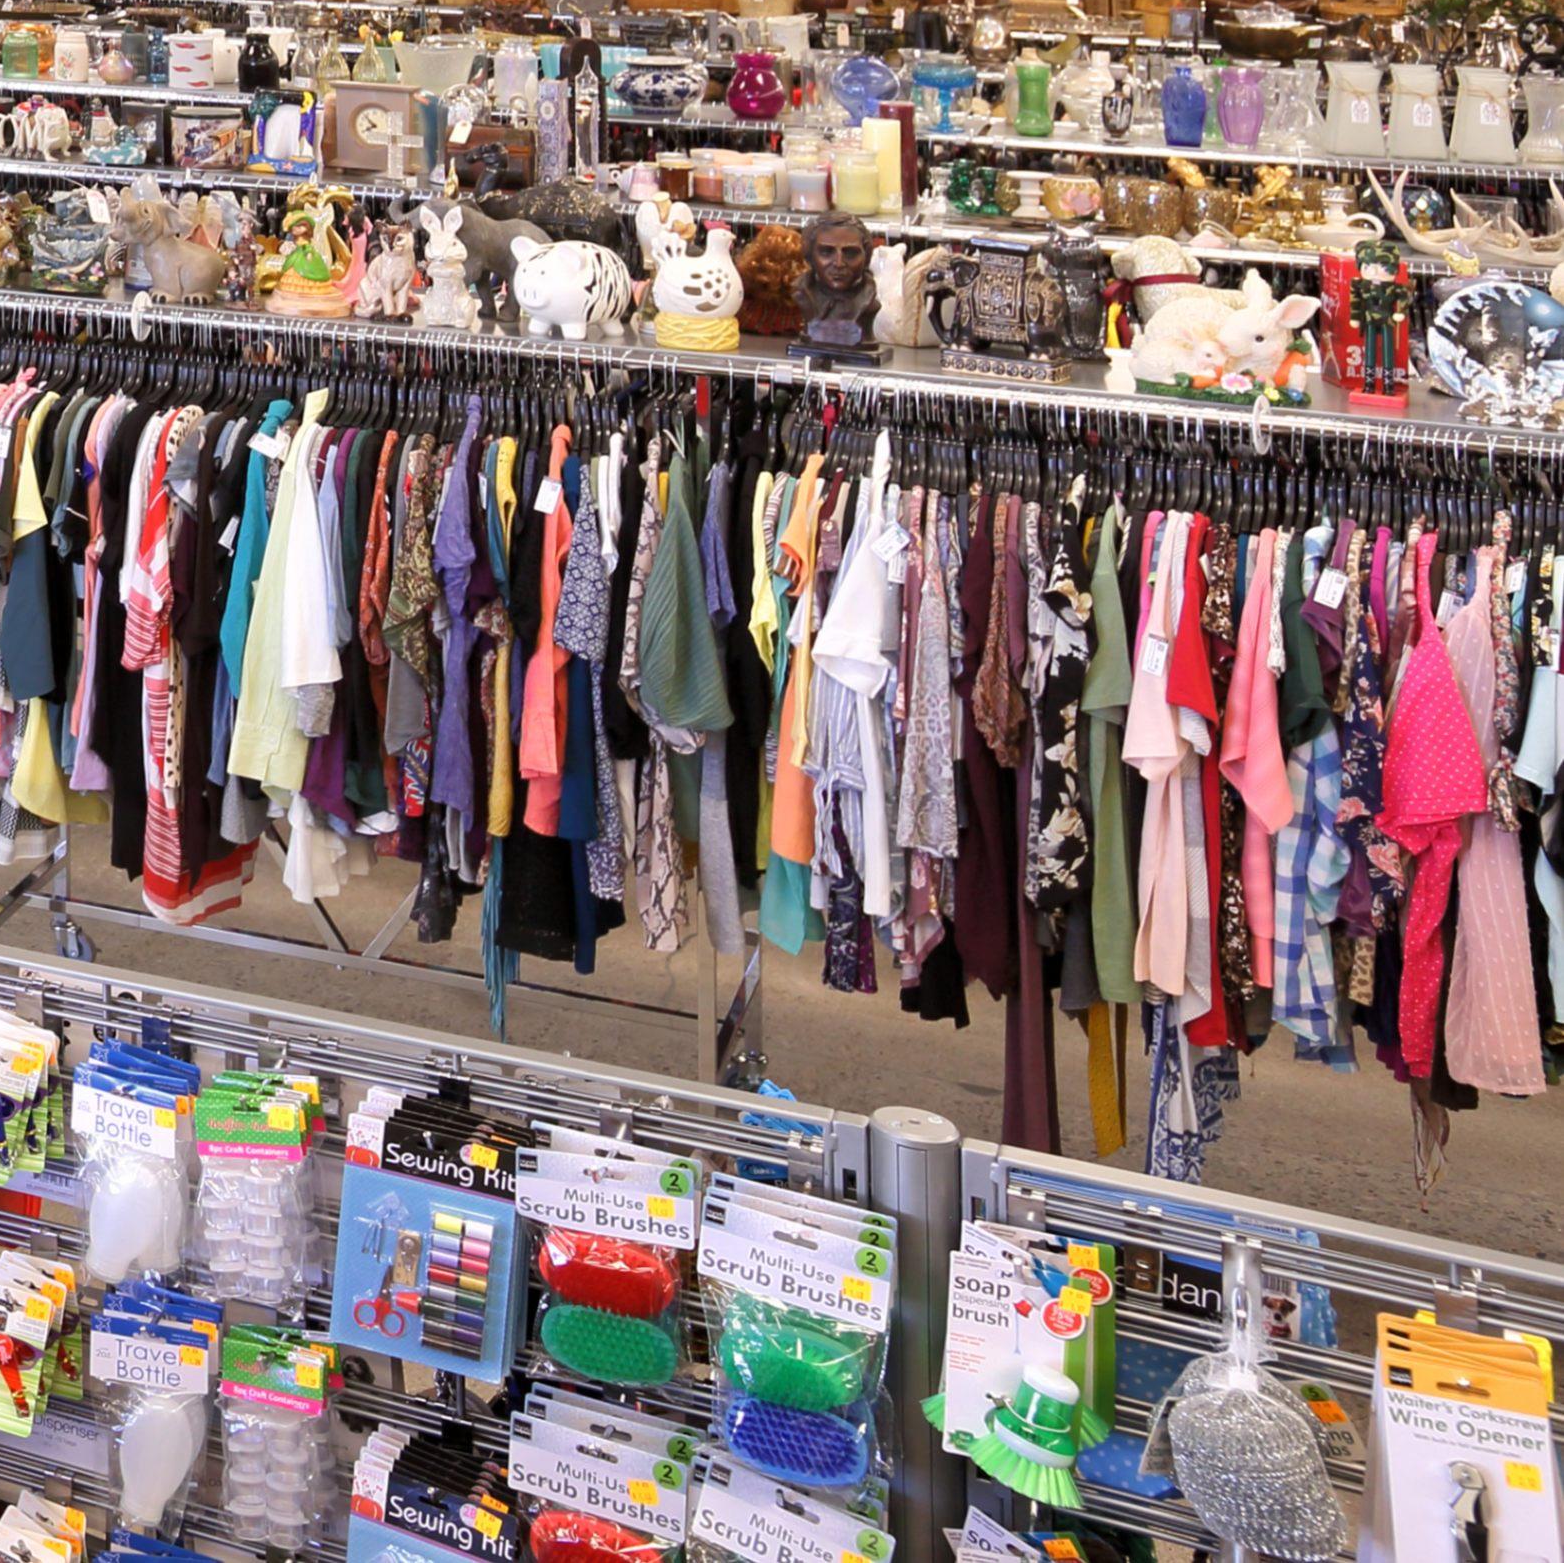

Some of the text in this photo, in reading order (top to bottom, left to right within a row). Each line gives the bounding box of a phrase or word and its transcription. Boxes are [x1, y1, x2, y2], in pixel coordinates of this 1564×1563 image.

[95, 1092, 153, 1127] Travel
[95, 1115, 152, 1148] Bottle
[225, 1145, 289, 1157] Craft Containers
[384, 1143, 516, 1193] Sewing Kit
[669, 1173, 679, 1187] 2
[564, 1187, 644, 1212] Multi-Use
[519, 1196, 690, 1240] Scrub Brushes
[749, 1247, 835, 1285] Multi-Use
[865, 1251, 877, 1266] 2
[702, 1248, 883, 1322] Scrub Brushes
[954, 1275, 1011, 1300] soap
[952, 1304, 1010, 1328] brush
[953, 1292, 1010, 1312] Dispensing
[115, 1338, 180, 1365] Trave
[116, 1359, 181, 1387] Bottle
[269, 1392, 310, 1410] Containers
[1387, 1390, 1547, 1433] Waiter's Corkscrew
[1388, 1406, 1448, 1433] Wine
[1456, 1420, 1546, 1452] Opener
[676, 1439, 688, 1455] 2
[663, 1464, 674, 1478] 2
[512, 1463, 682, 1533] Scrub Brushes
[388, 1495, 473, 1551] Sewing
[699, 1509, 768, 1555] Scrub
[749, 1513, 834, 1563] Multi-Use
[866, 1534, 878, 1549] 2
